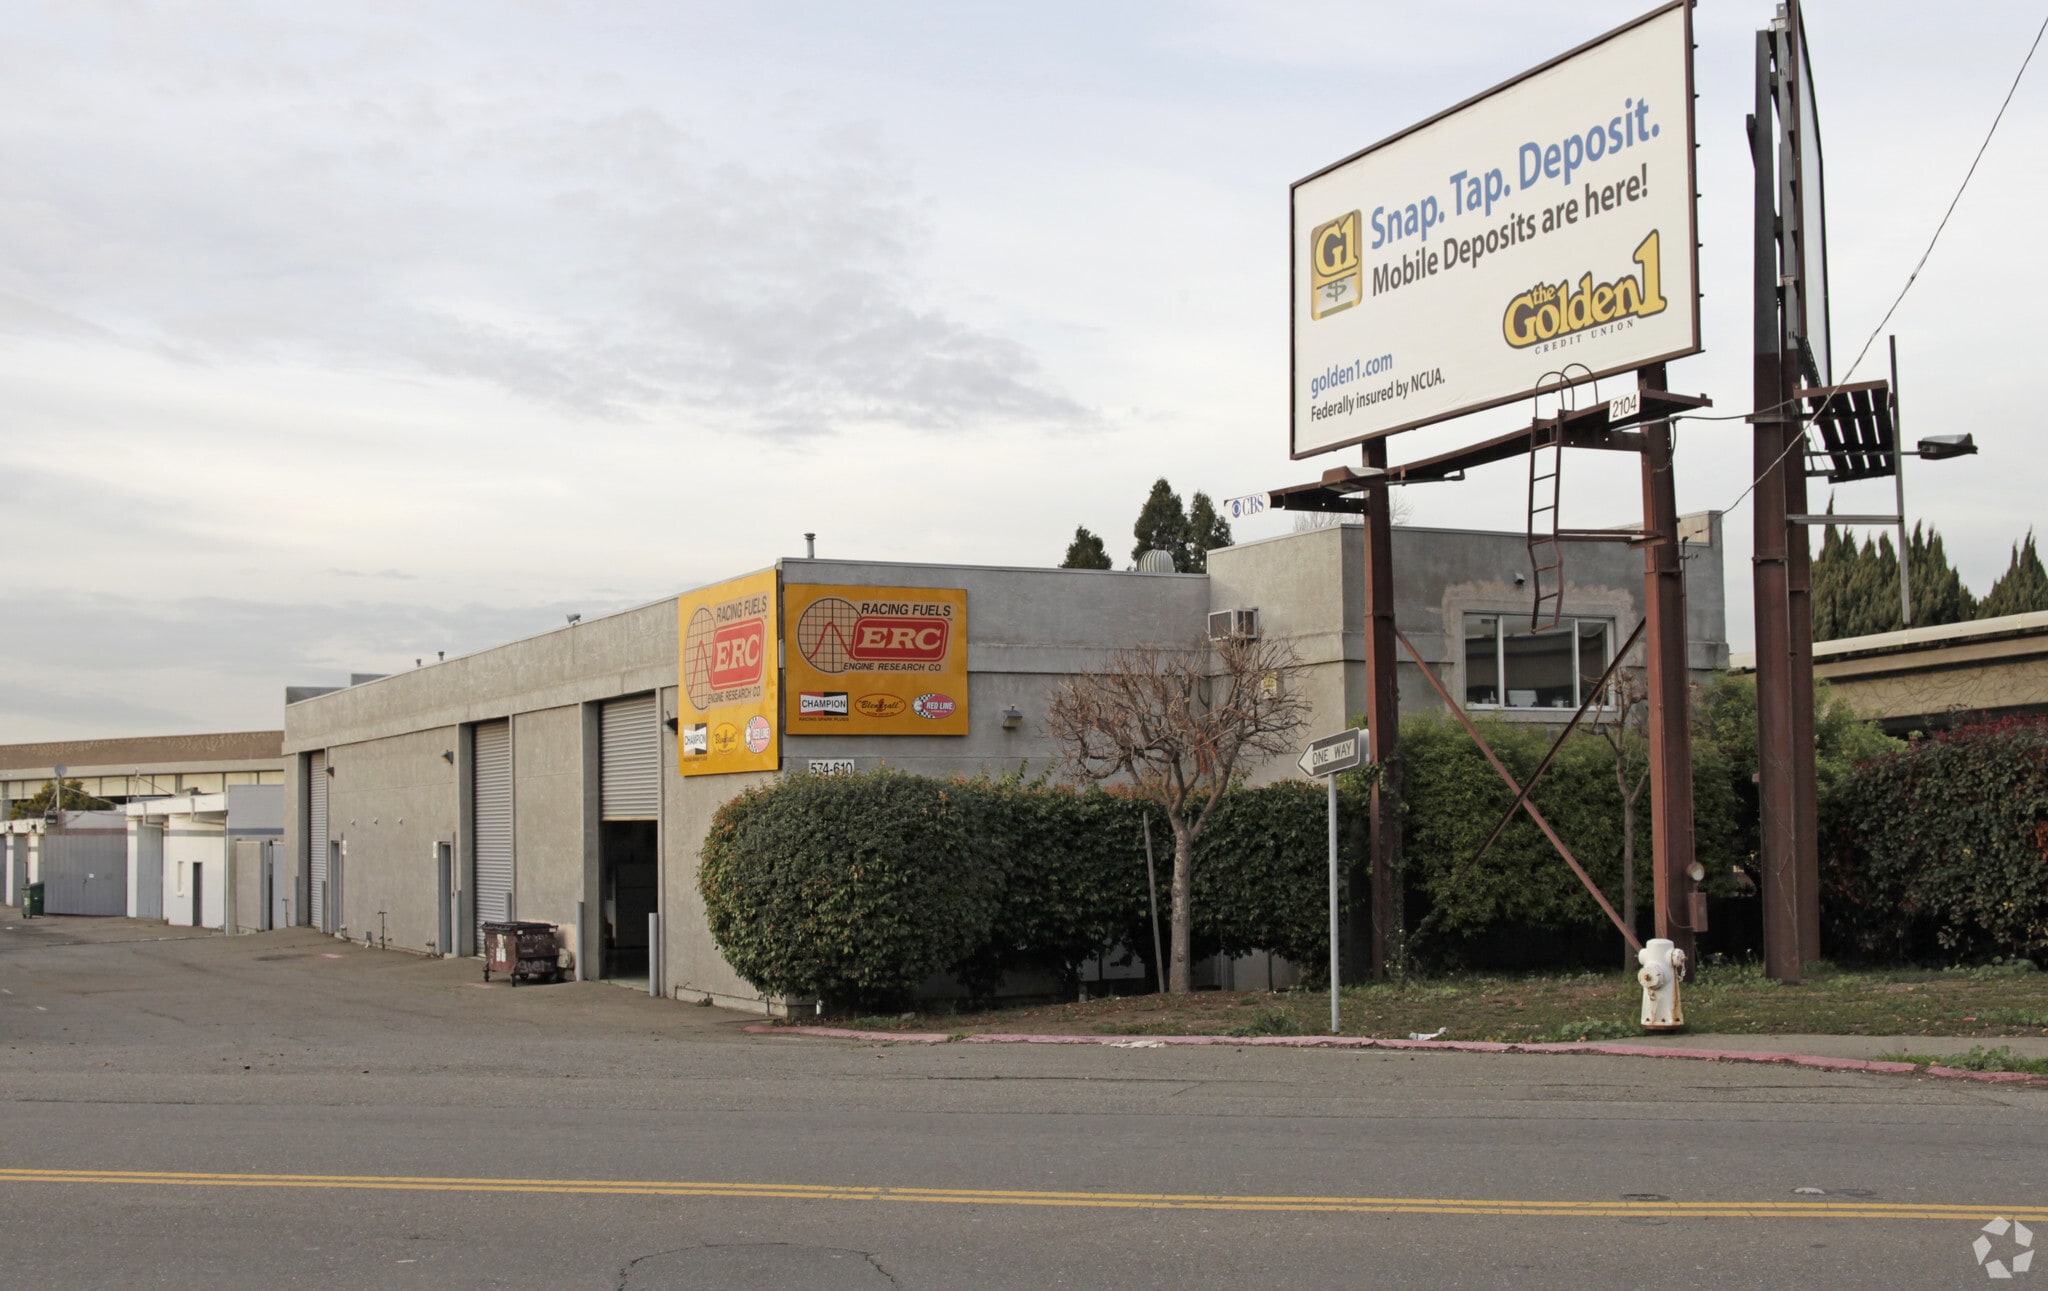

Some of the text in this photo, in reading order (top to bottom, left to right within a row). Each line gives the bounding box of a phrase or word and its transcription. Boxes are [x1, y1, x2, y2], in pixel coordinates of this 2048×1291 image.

[1371, 97, 1660, 250] Snap. Tap. Deposit.
[1372, 162, 1648, 297] Mobile Deposits are here!
[1314, 212, 1359, 277] G1
[1531, 283, 1557, 305] the
[1534, 319, 1635, 355] CREDIT UNION
[1311, 353, 1393, 399] golden1.com
[1311, 367, 1446, 421] Federally insured by NCUA.
[1612, 395, 1638, 418] 2104
[1242, 494, 1265, 516] CBS
[716, 595, 767, 622] RACING FUELS
[861, 602, 952, 617] RACING FUELS
[857, 626, 942, 651] ERC
[714, 633, 761, 673] ERC
[843, 662, 942, 672] ENGINE RESEARCH CO
[725, 687, 751, 702] RESEARCH
[801, 699, 846, 708] CHAMPION
[1312, 741, 1353, 765] ONE WAY
[811, 762, 853, 776] 574-610
